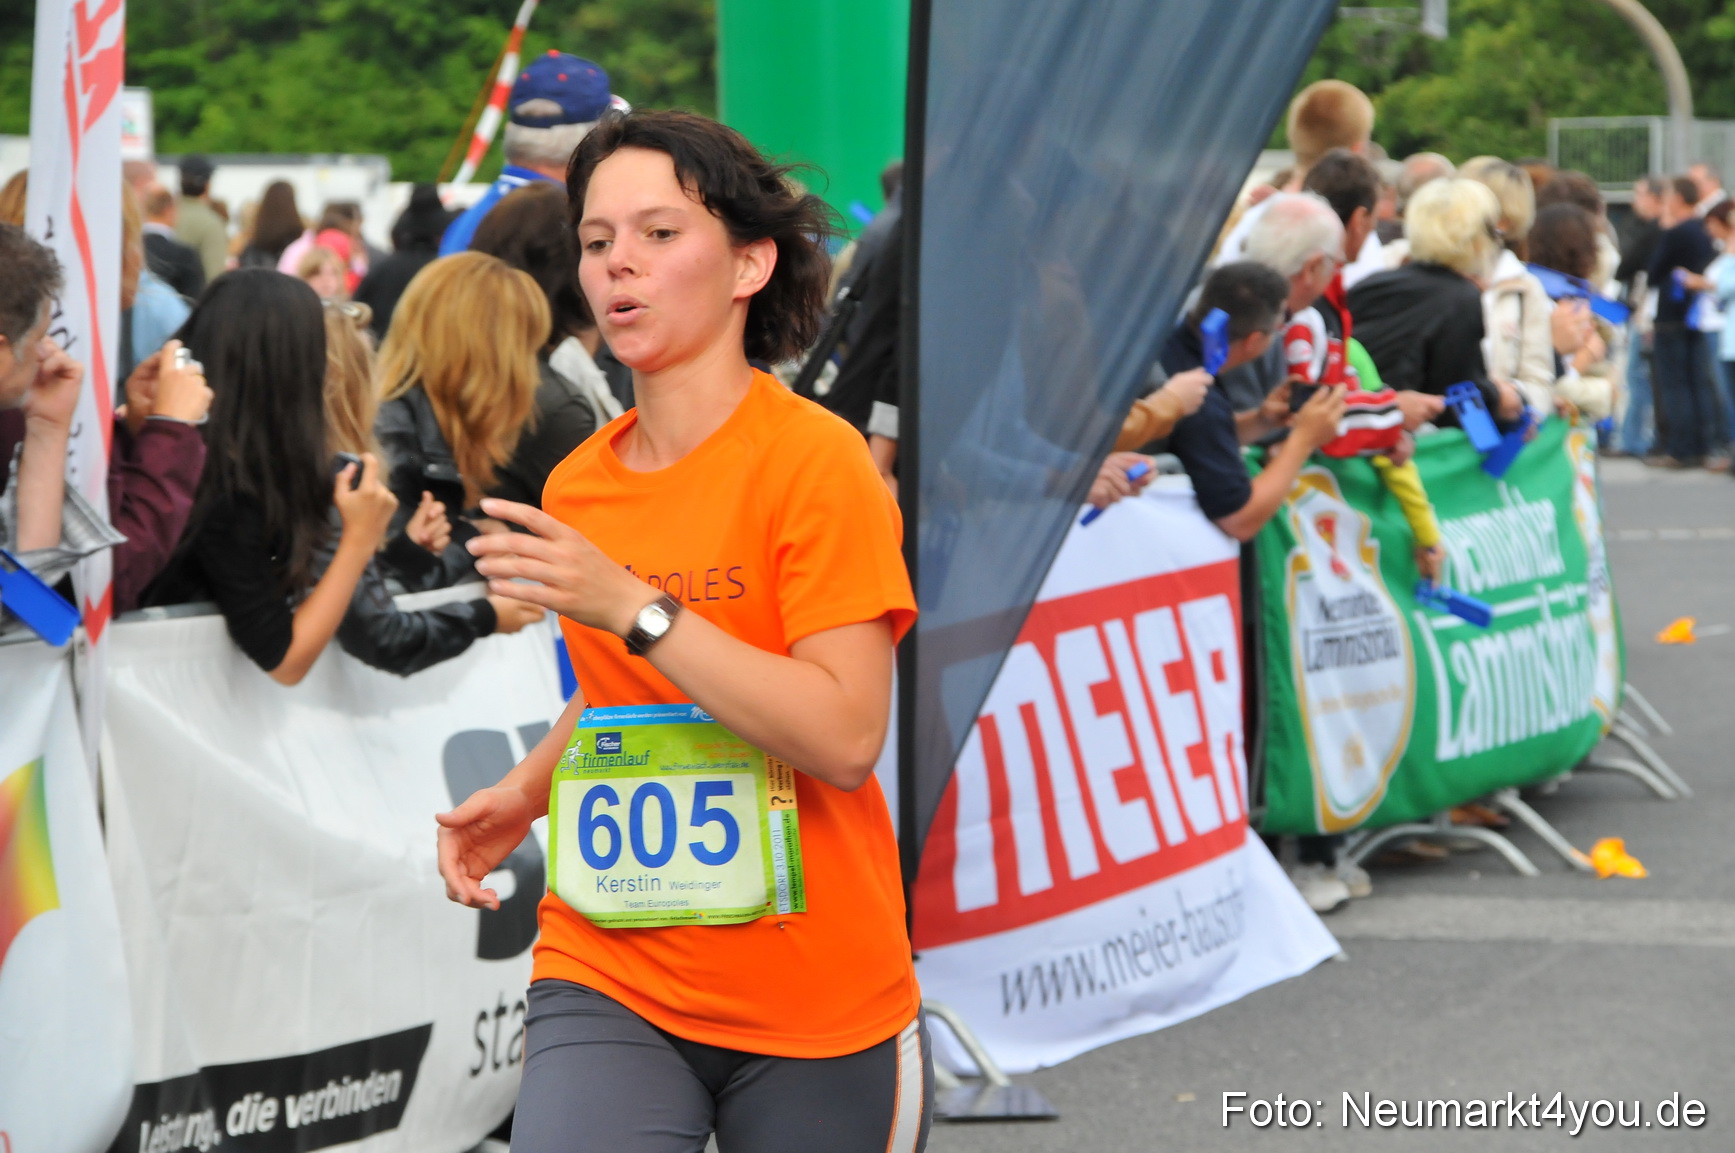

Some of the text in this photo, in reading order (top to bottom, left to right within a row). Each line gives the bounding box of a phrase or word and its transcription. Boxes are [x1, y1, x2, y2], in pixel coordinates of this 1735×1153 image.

[583, 750, 651, 768] firmenlauf
[941, 593, 1248, 913] MEIER
[578, 780, 740, 871] 605
[596, 874, 722, 894] Kerstin Weidinger
[624, 899, 689, 909] Team Europoles
[226, 1091, 278, 1137] die
[285, 1069, 403, 1129] verbinden
